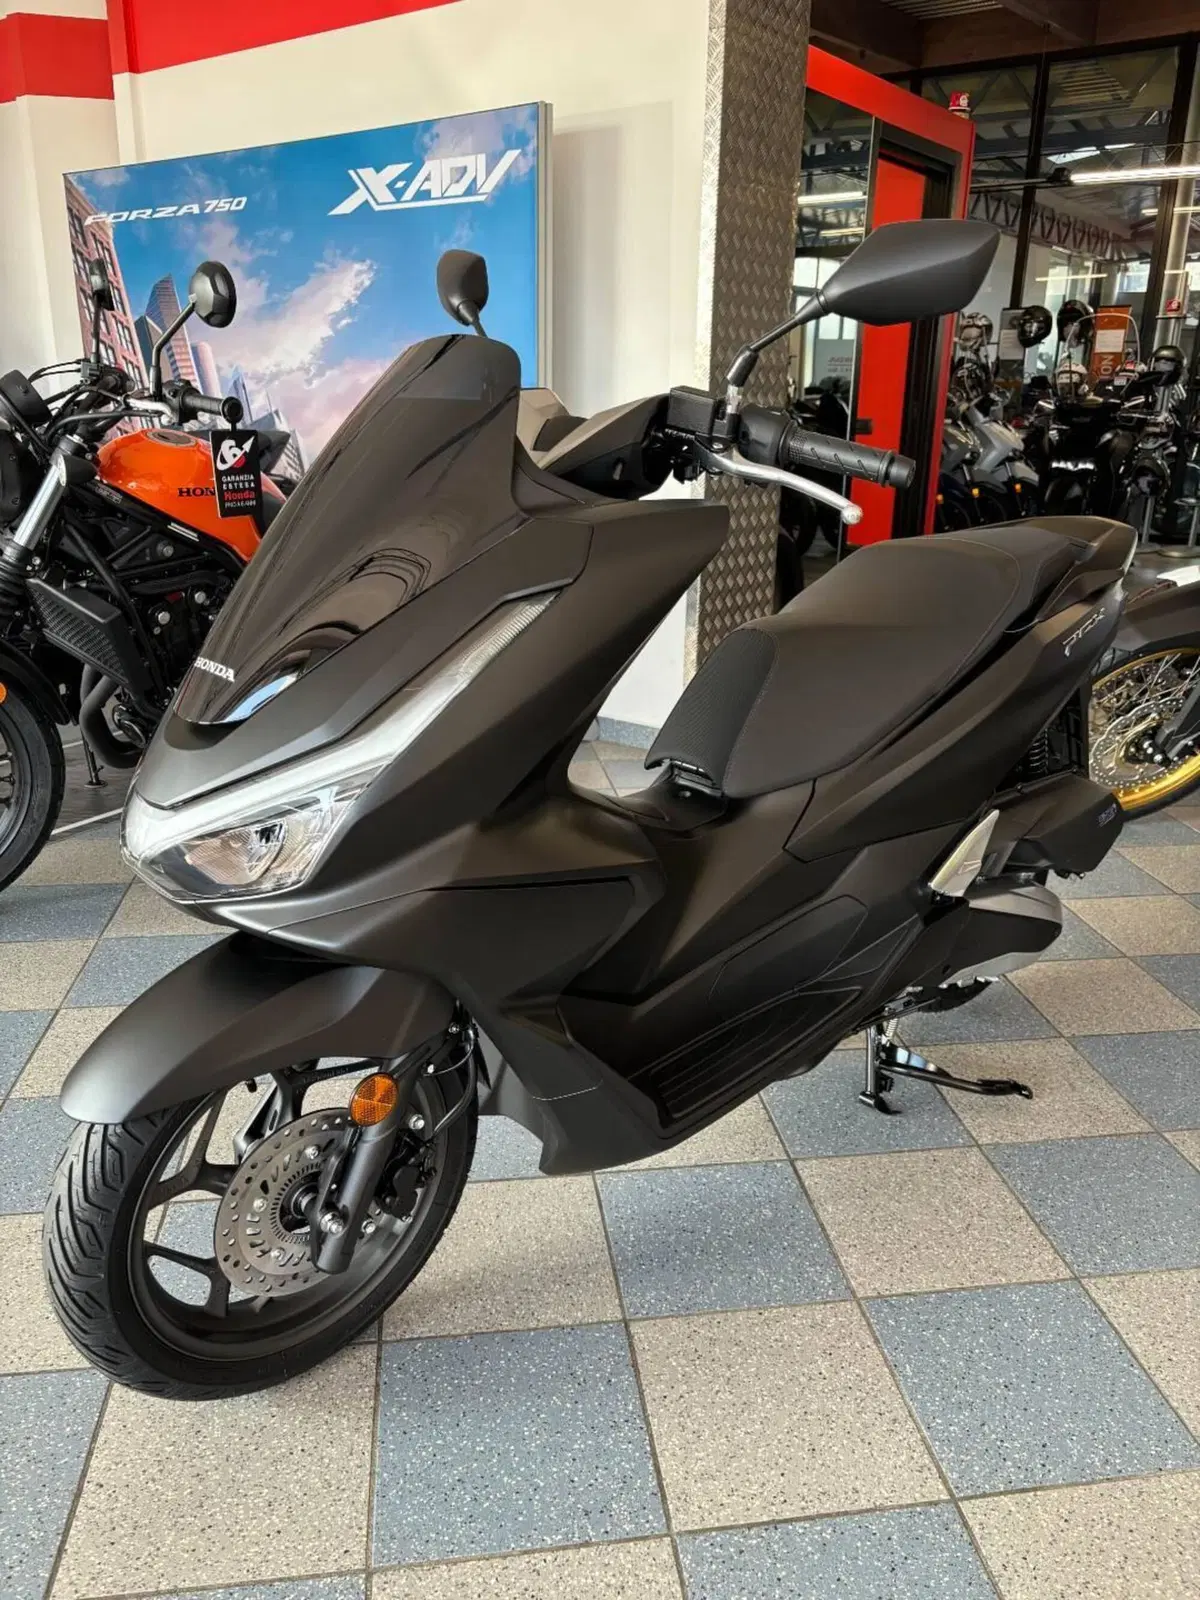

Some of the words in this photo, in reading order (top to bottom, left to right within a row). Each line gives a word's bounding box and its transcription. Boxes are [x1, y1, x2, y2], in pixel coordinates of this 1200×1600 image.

[326, 149, 522, 216] X-ADV
[84, 203, 201, 226] FORZA
[203, 196, 248, 214] 750
[221, 473, 255, 483] GARANZIA
[177, 487, 216, 497] HON
[224, 489, 256, 501] Honda
[193, 656, 236, 683] HONDA
